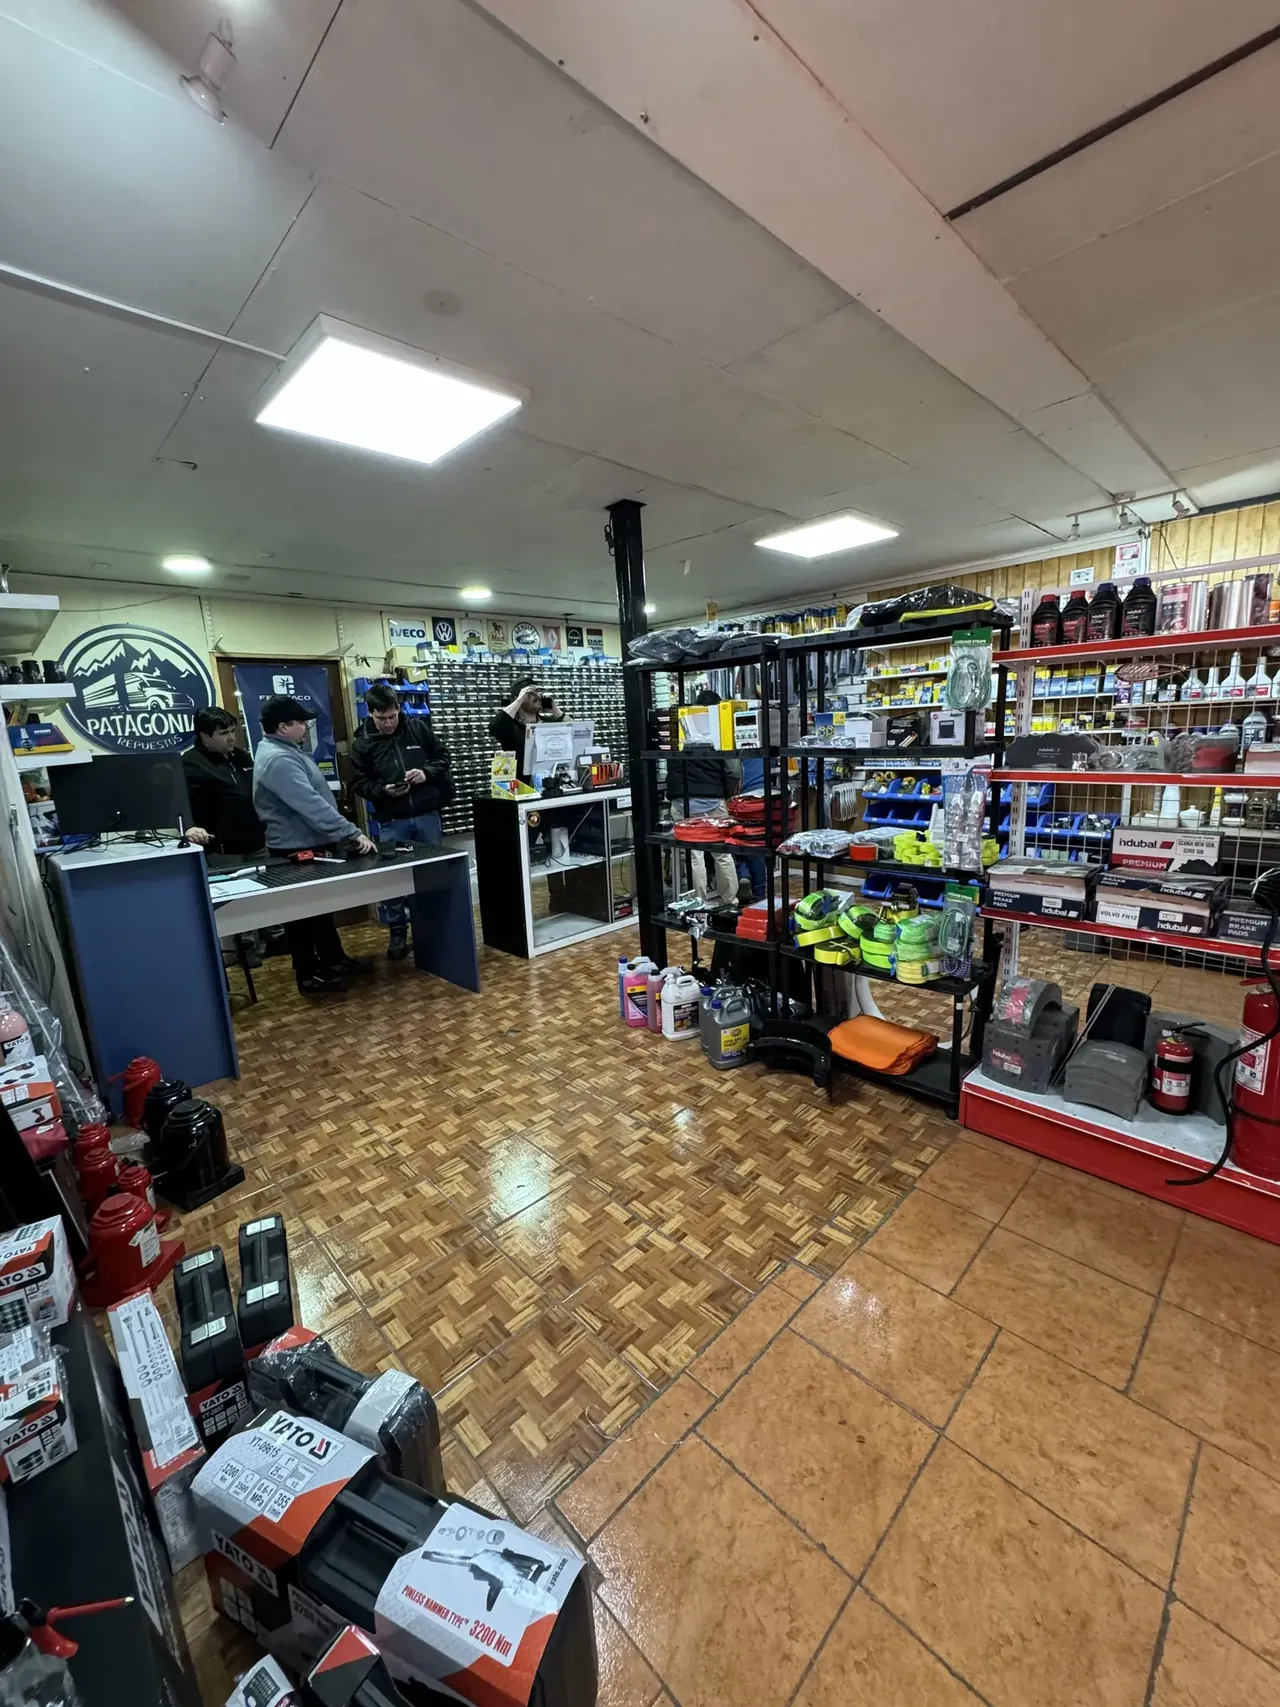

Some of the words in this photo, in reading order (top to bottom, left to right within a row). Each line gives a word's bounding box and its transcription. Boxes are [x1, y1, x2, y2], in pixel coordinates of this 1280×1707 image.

[390, 628, 426, 638] IVECO
[117, 734, 184, 750] REPUESTOS
[1118, 837, 1158, 850] indubal
[1122, 858, 1168, 870] PREMIUM
[993, 891, 1020, 899] PREMIUM
[1160, 887, 1193, 897] indubal
[1041, 907, 1068, 917] indubal
[1121, 913, 1138, 921] FH12
[1157, 922, 1189, 933] indubal
[1228, 923, 1257, 932] BRAKE
[1229, 917, 1268, 927] PREMIUM
[1227, 929, 1249, 937] PADS
[6, 1036, 25, 1048] YATO
[4, 1247, 33, 1258] YATO
[201, 1391, 230, 1407] YATO
[4, 1423, 38, 1446] YATO
[269, 1415, 315, 1447] YATO
[250, 1436, 281, 1458] YT-09615
[221, 1463, 239, 1478] 3200
[270, 1466, 281, 1477] 25
[257, 1482, 273, 1496] 0.6-1
[251, 1493, 264, 1507] MPa
[273, 1493, 291, 1509] 355
[215, 1533, 254, 1573] YATO
[402, 1584, 425, 1606] PINLESS
[425, 1597, 449, 1620] HAMMER
[469, 1620, 497, 1647] 3200
[494, 1634, 513, 1657] Nm
